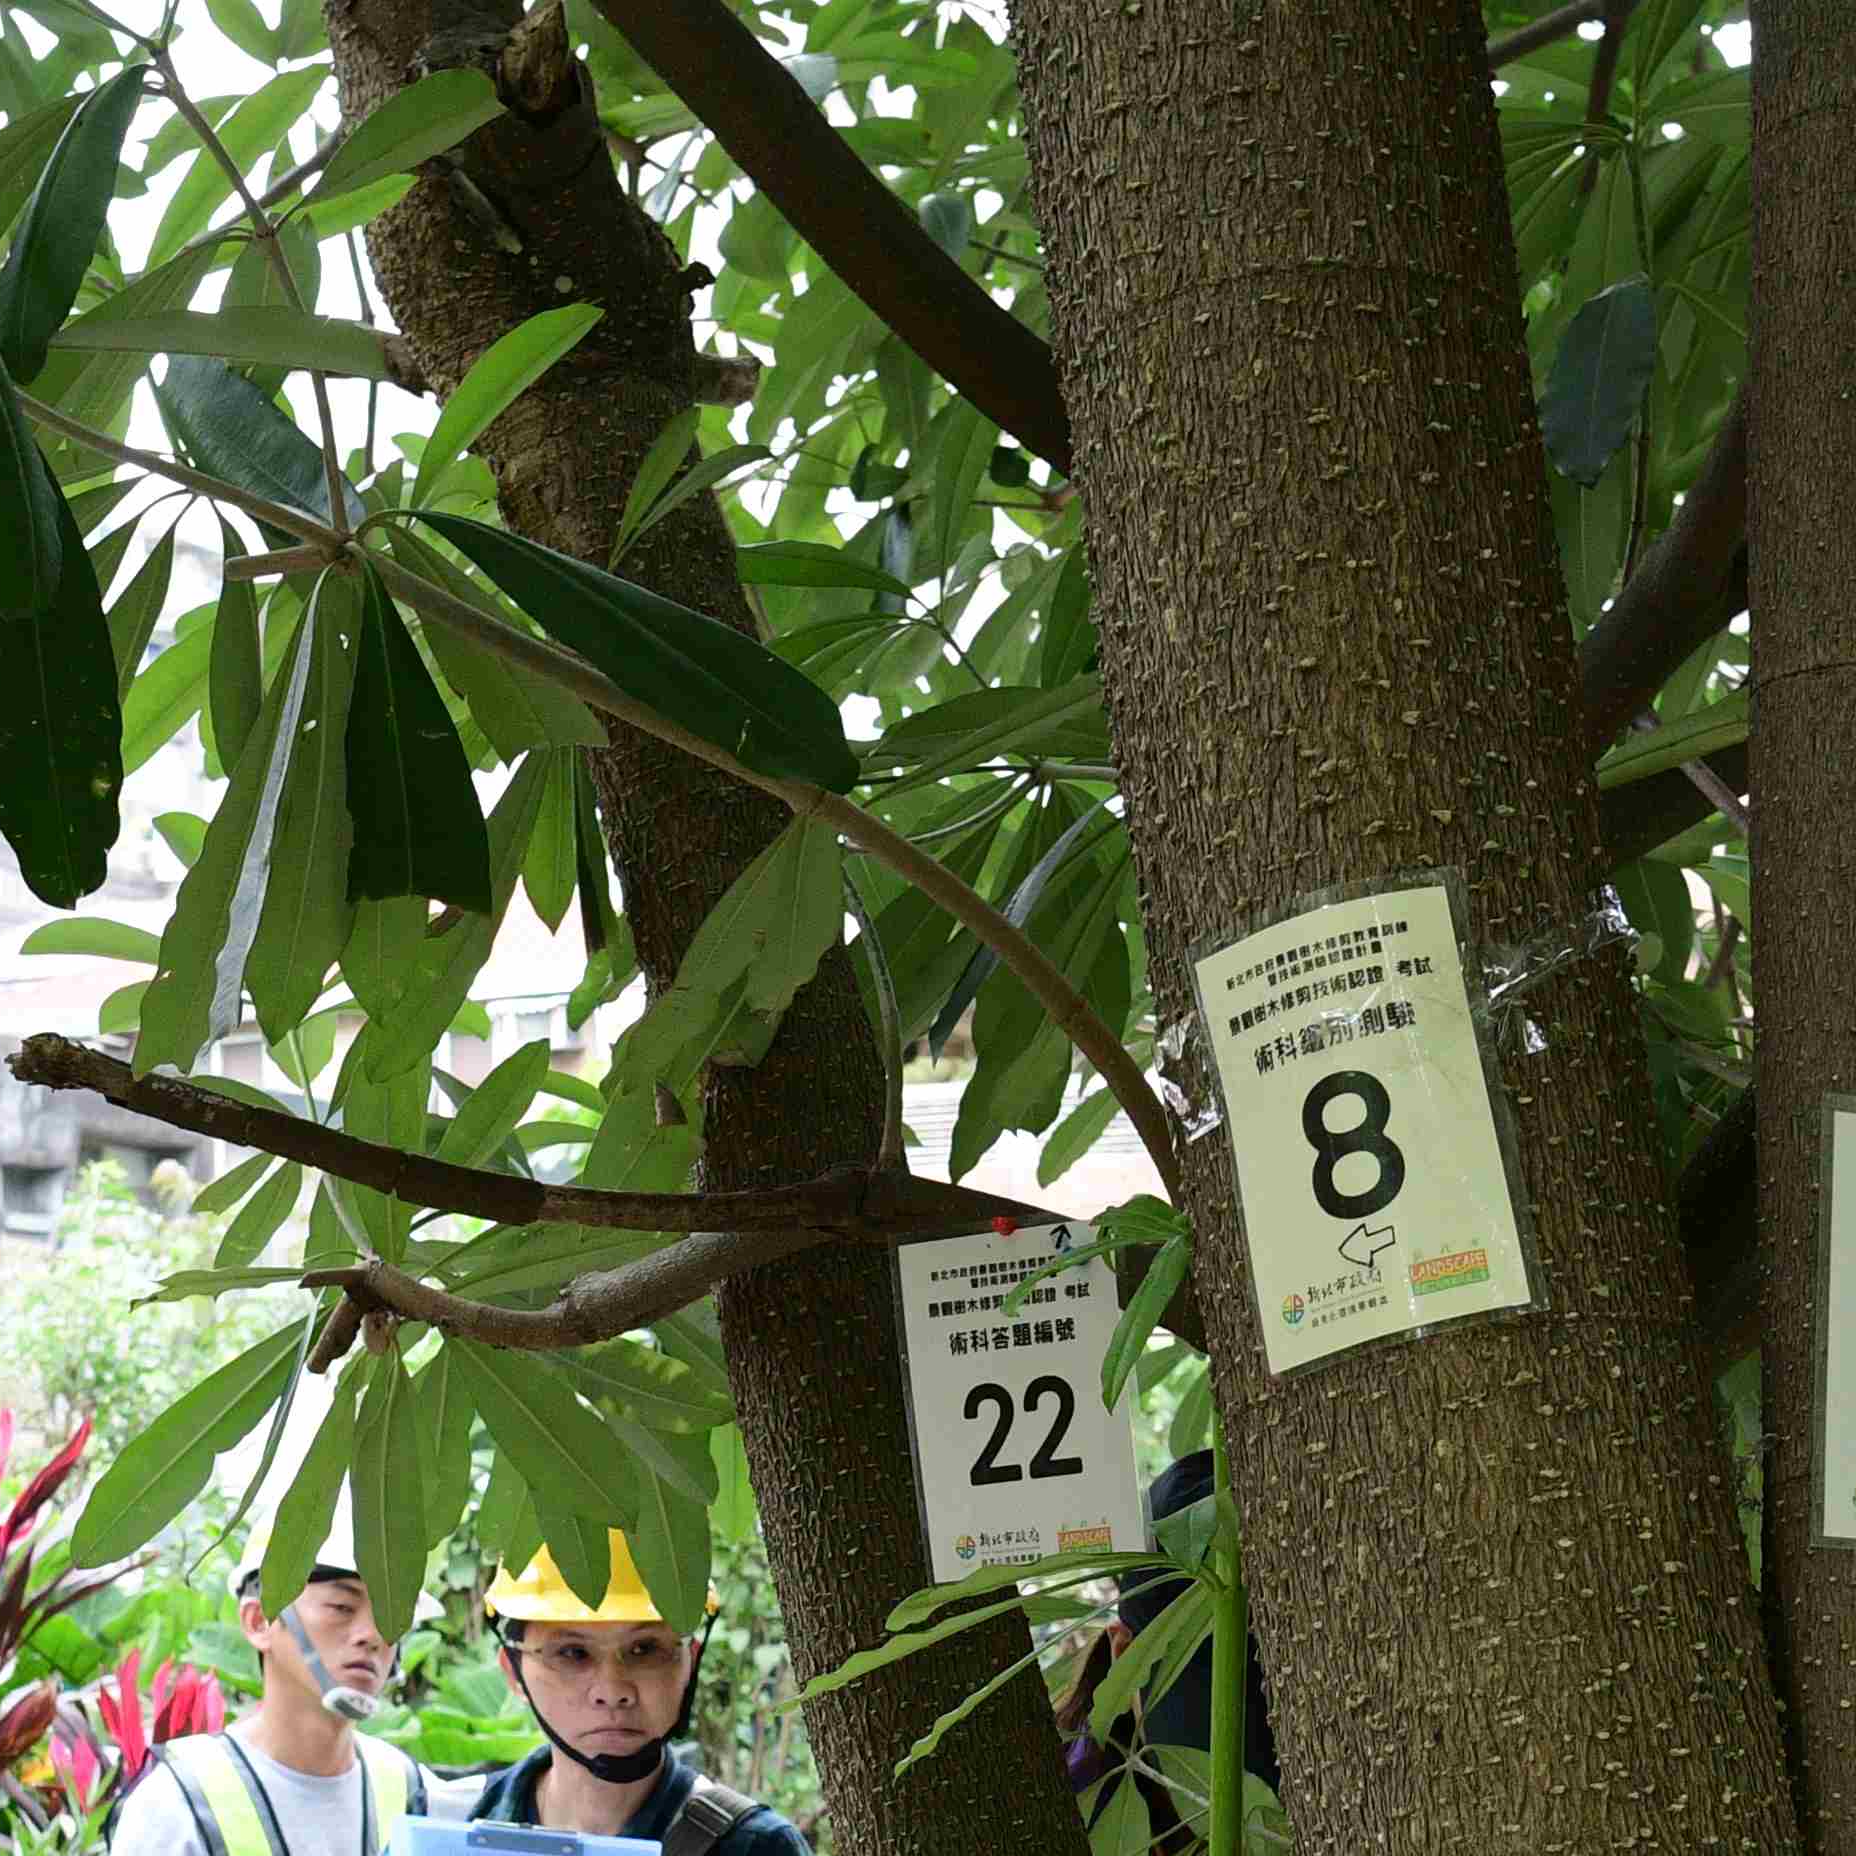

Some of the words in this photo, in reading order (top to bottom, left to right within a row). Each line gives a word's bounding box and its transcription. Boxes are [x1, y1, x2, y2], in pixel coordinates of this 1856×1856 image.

[1229, 965, 1384, 1037] 景觀樹木修剪技術認證
[1397, 956, 1433, 977] 考試
[1302, 1070, 1406, 1220] 8
[929, 1287, 1056, 1318] 景觀樹木修剪認證
[1064, 1282, 1090, 1299] 考試
[949, 1317, 1075, 1356] 術科答題編號
[964, 1375, 1083, 1487] 22
